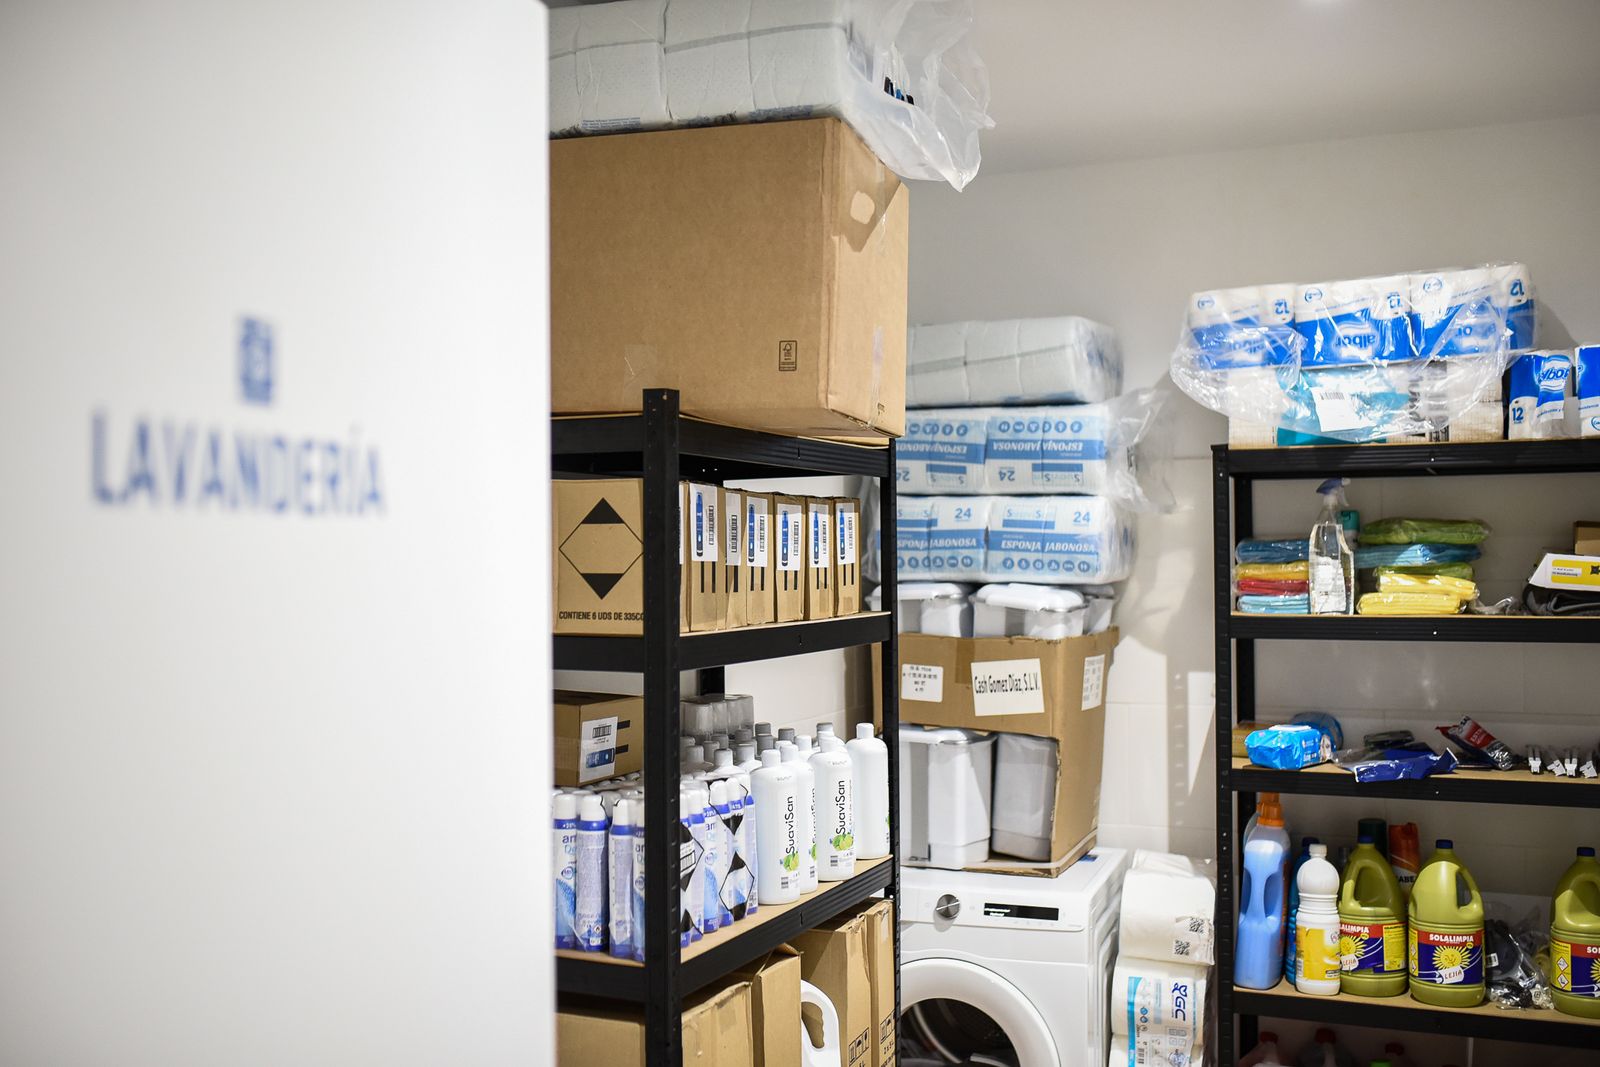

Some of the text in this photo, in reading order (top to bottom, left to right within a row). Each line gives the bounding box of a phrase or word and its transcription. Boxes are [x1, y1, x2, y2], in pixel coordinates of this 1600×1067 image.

[1335, 332, 1376, 350] albor
[1511, 406, 1524, 421] 12
[930, 442, 968, 454] ESPONJ
[992, 439, 1084, 452] ESPONJA JABONOSA
[998, 470, 1016, 481] 24
[954, 507, 972, 519] 24
[1073, 511, 1090, 523] 24
[929, 537, 977, 549] JABONOSA
[1000, 539, 1095, 553] ESPONJA JABONOSA
[558, 610, 591, 620] CONTIENE
[591, 611, 597, 620] 6
[597, 611, 612, 620] UDS
[613, 612, 623, 620] DE
[973, 674, 988, 694] Cash
[835, 780, 846, 835] SuaviSan
[784, 795, 795, 855] SuaviSan
[1340, 923, 1370, 934] ALIMPIA
[1429, 933, 1474, 943] SOLALIMPIA
